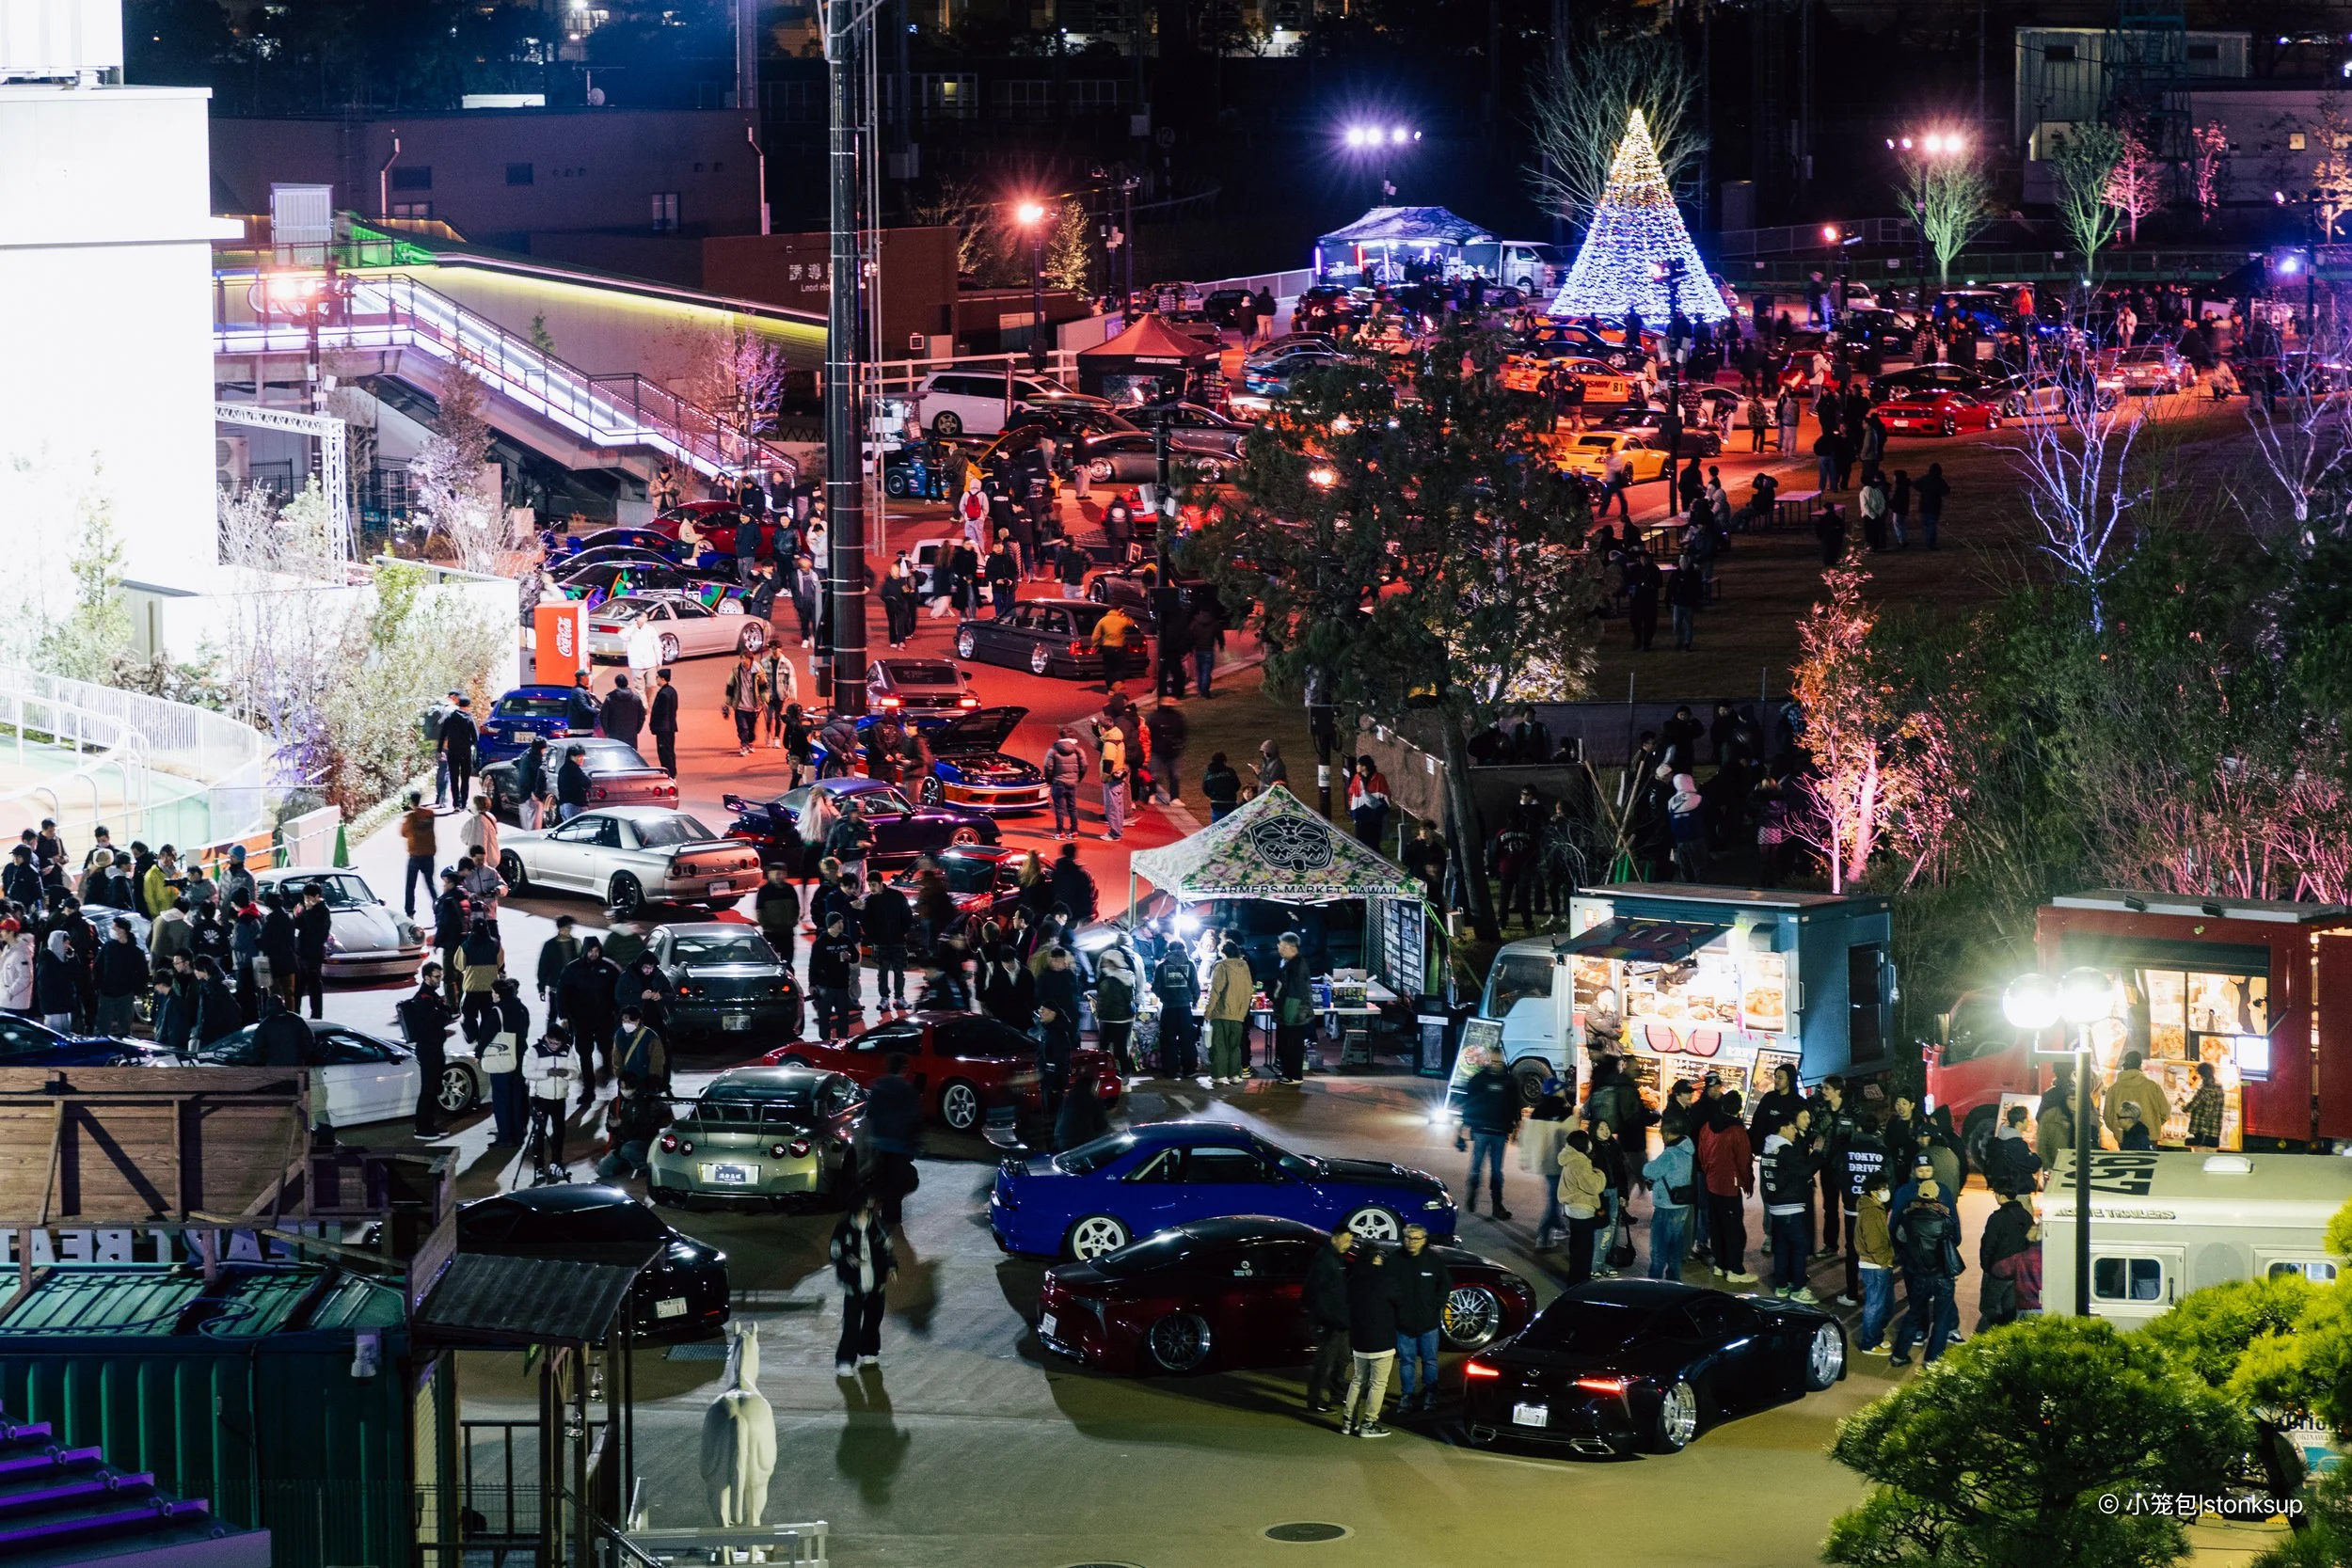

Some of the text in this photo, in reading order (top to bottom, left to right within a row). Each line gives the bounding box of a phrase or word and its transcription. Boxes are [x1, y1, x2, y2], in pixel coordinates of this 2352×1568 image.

[788, 263, 832, 280] 誘導
[1613, 382, 1623, 392] 81
[1213, 884, 1398, 895] FARMERS MARKET HAWAII
[1848, 1151, 1883, 1163] TOKYO
[2105, 1208, 2176, 1220] TRAILERS
